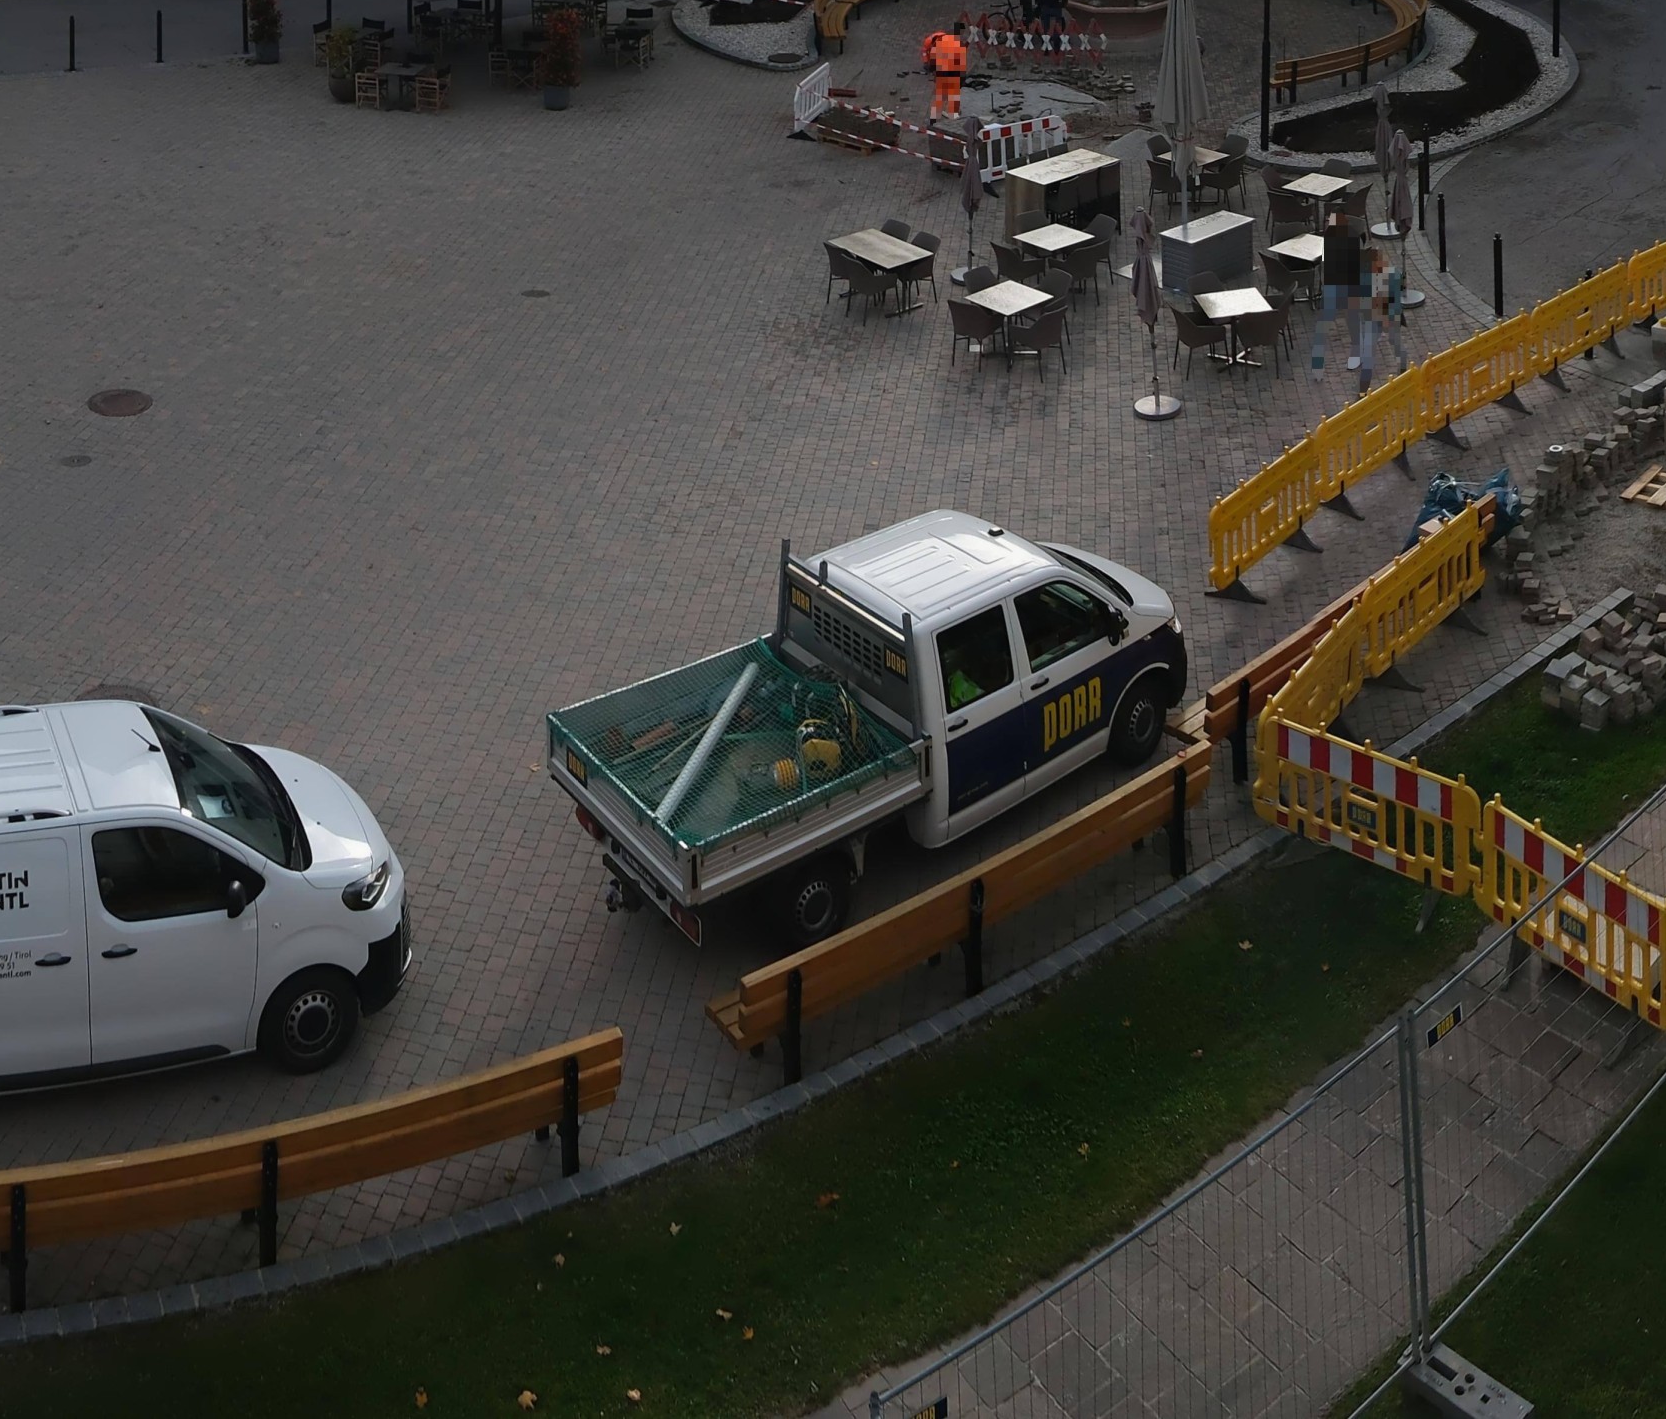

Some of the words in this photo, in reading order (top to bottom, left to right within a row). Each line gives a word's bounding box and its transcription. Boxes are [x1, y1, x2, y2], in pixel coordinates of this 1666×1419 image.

[1044, 676, 1101, 752] PORR
[14, 950, 32, 960] Tirol
[5, 962, 15, 970] 51
